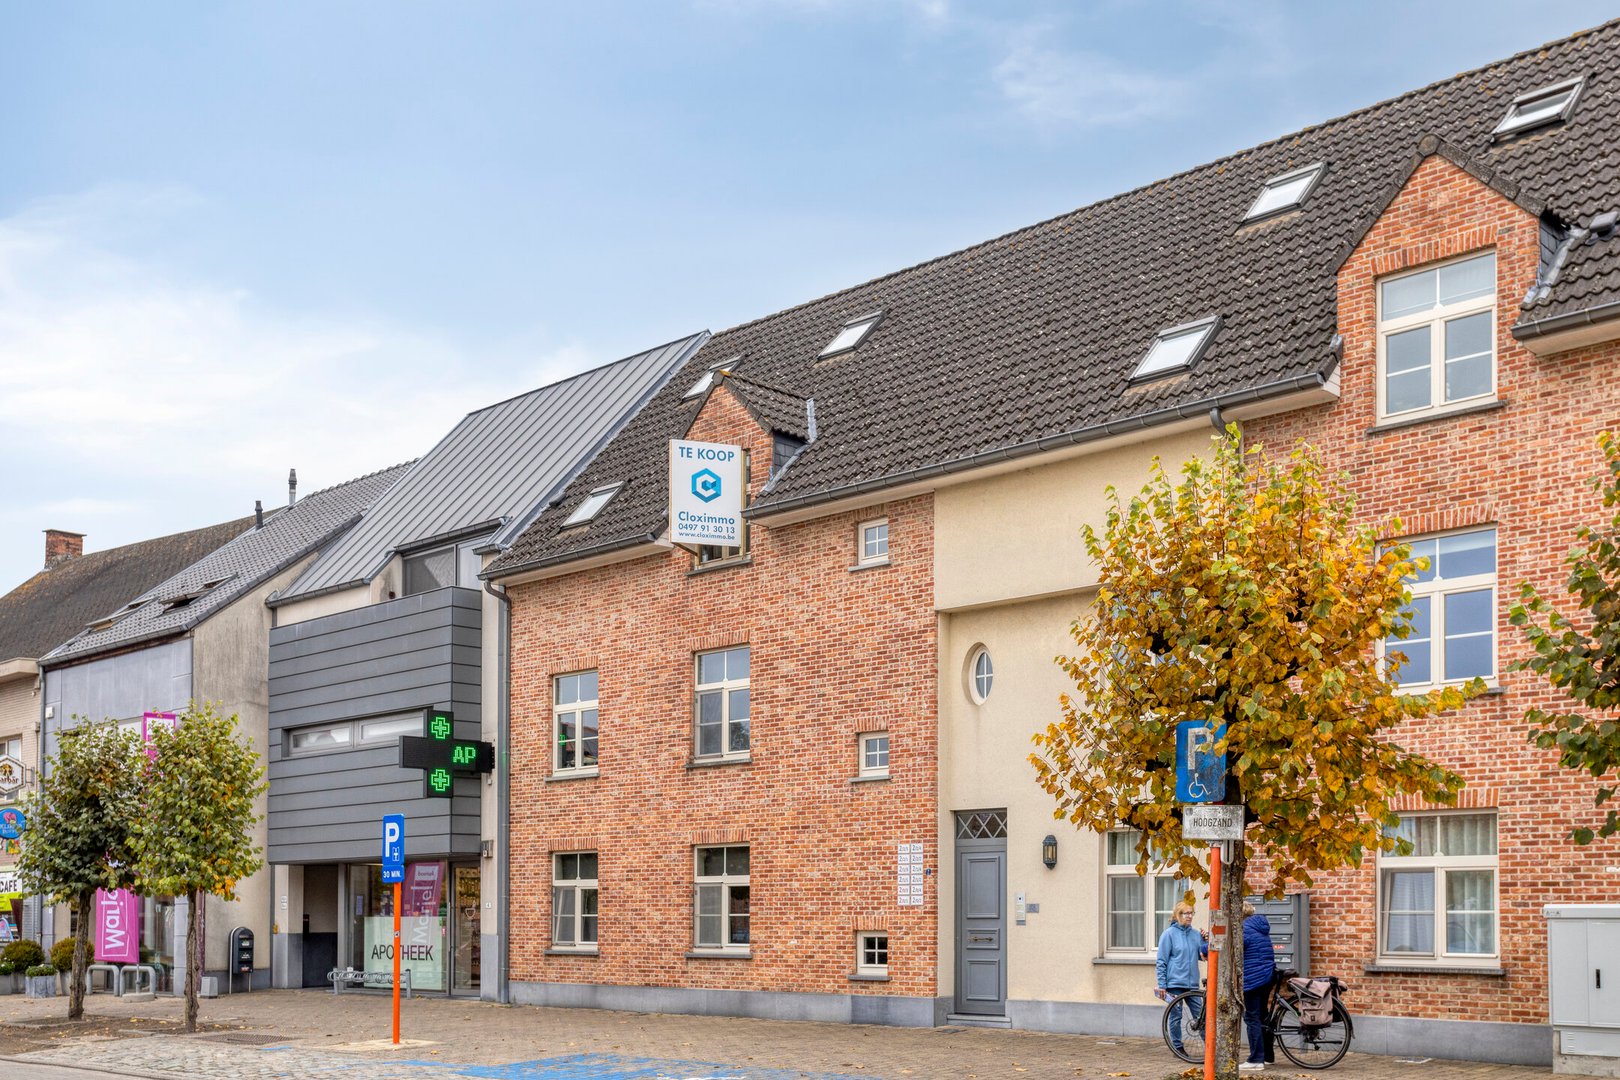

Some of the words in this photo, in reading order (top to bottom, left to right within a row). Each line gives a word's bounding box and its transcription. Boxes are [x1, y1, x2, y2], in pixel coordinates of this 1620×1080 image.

[679, 446, 692, 458] TE
[698, 448, 735, 462] KOOP
[678, 511, 735, 525] Cloximmo
[678, 522, 698, 531] 0497
[701, 524, 709, 532] 91
[713, 525, 723, 533] 30
[726, 526, 735, 534] 13
[678, 531, 735, 540] www.cloximmo.be
[453, 746, 476, 764] AP
[1188, 728, 1214, 769] P
[1193, 817, 1232, 828] HOOGZAND
[385, 822, 399, 857] P
[383, 870, 390, 878] 30
[371, 944, 433, 961] APOHEEK
